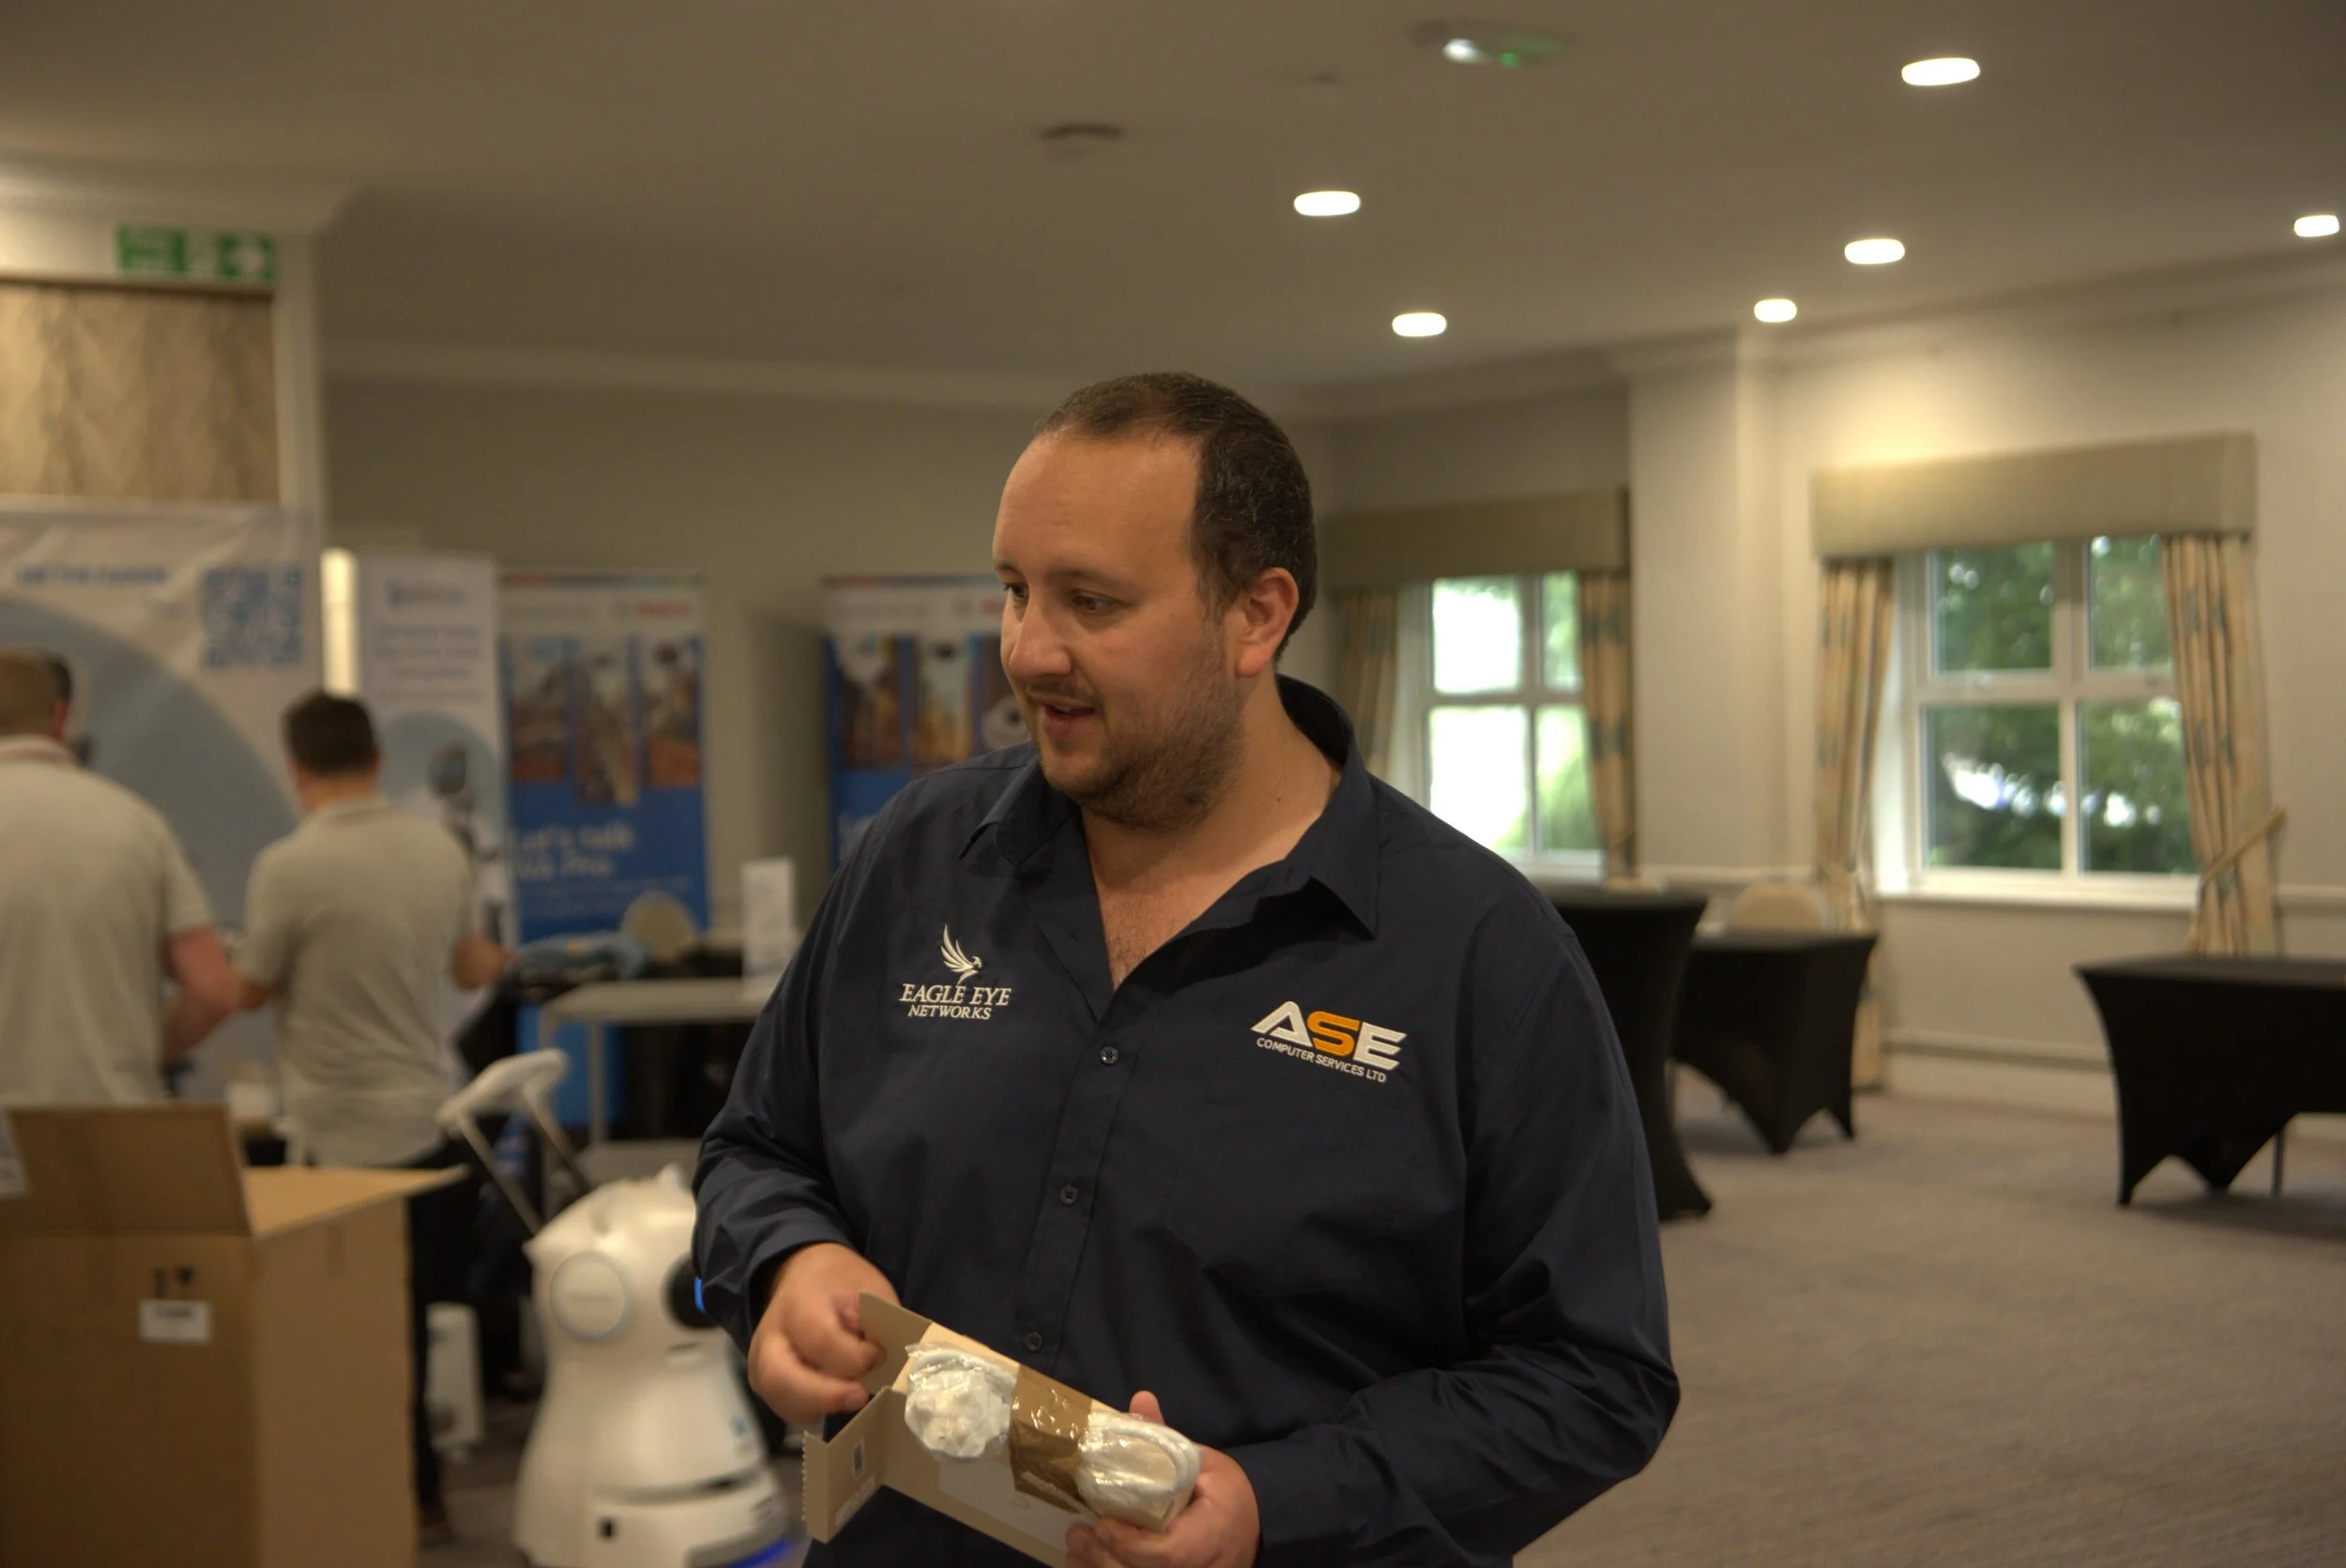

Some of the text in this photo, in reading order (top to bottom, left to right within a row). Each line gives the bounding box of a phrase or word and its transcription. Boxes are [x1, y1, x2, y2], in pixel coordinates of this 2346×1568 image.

[899, 982, 1012, 1006] EAGLE EYE
[907, 1004, 992, 1020] NETWORKS
[1250, 1000, 1408, 1071] ASE
[1257, 1037, 1387, 1084] COMPUTER SERVICES LTD
